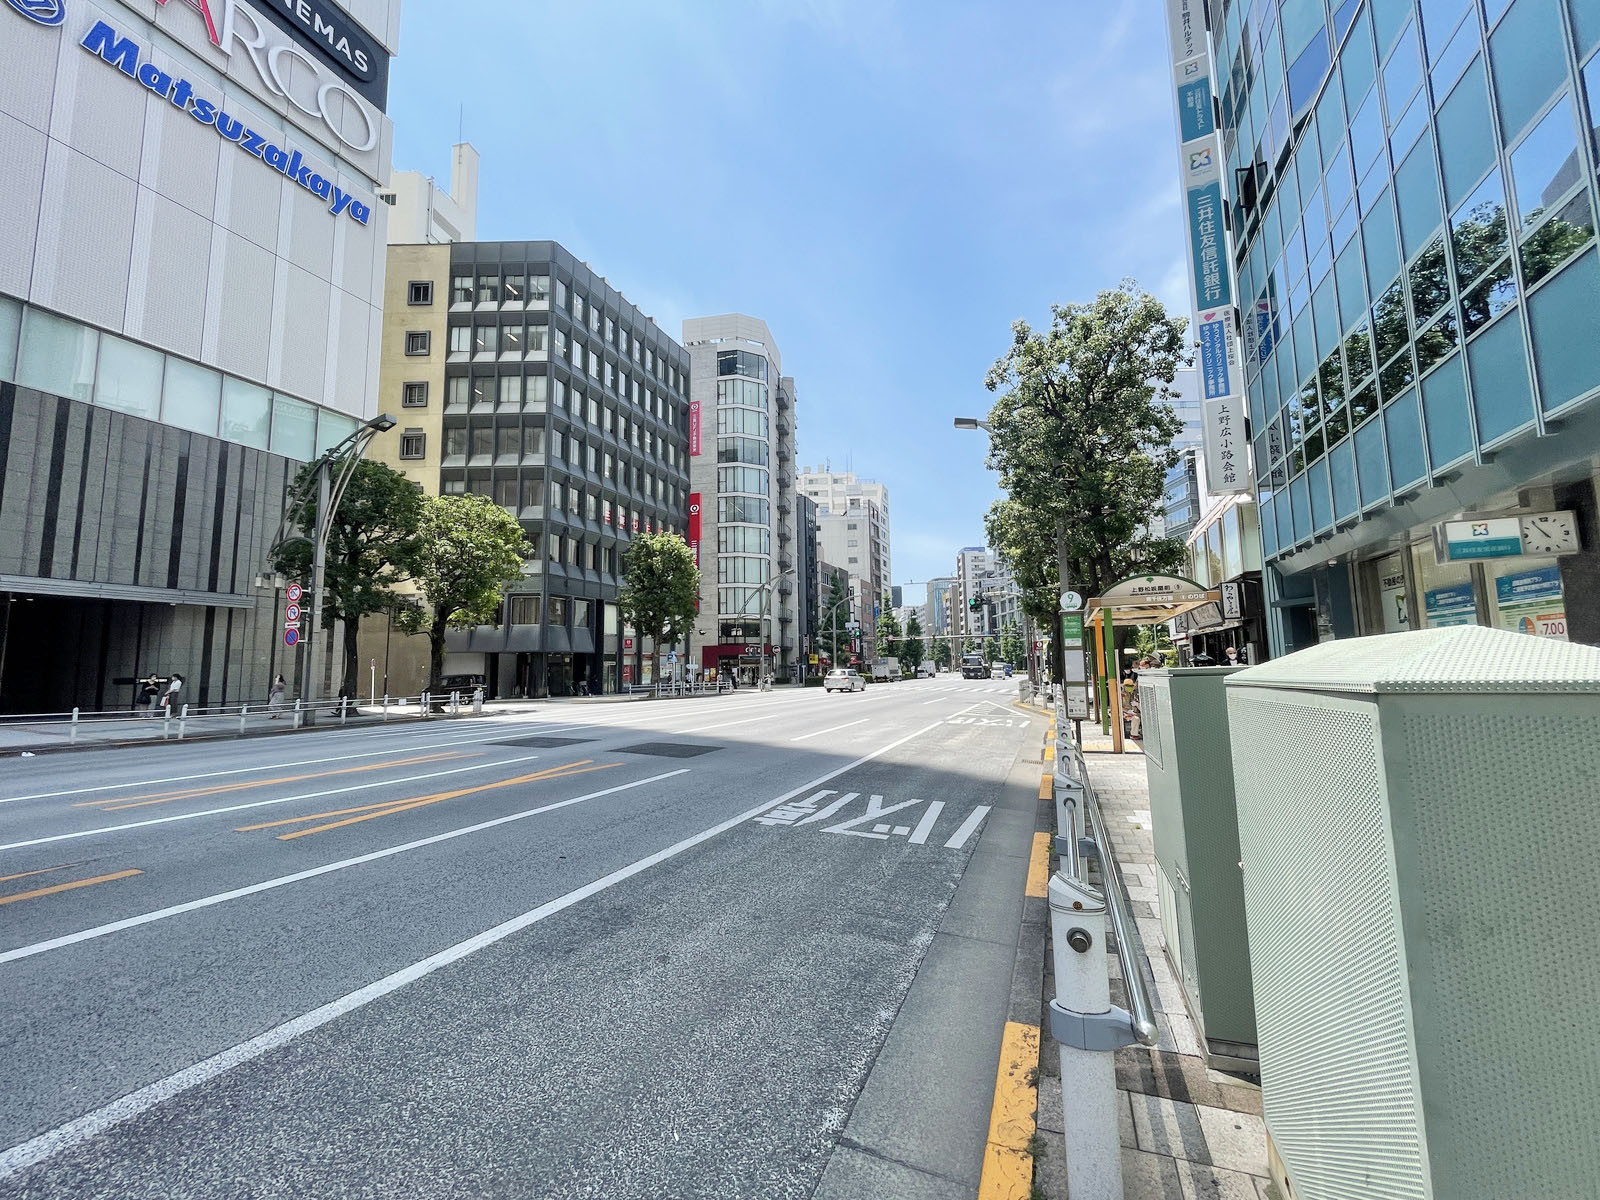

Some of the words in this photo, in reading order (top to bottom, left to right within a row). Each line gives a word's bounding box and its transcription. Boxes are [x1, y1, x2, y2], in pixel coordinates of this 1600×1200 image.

[79, 18, 371, 226] Matsuzakaya
[1197, 195, 1221, 301] 三井住友信託銀行
[1218, 404, 1236, 483] 上野広小路会館
[1067, 594, 1074, 603] 9
[1542, 622, 1565, 636] 7.00
